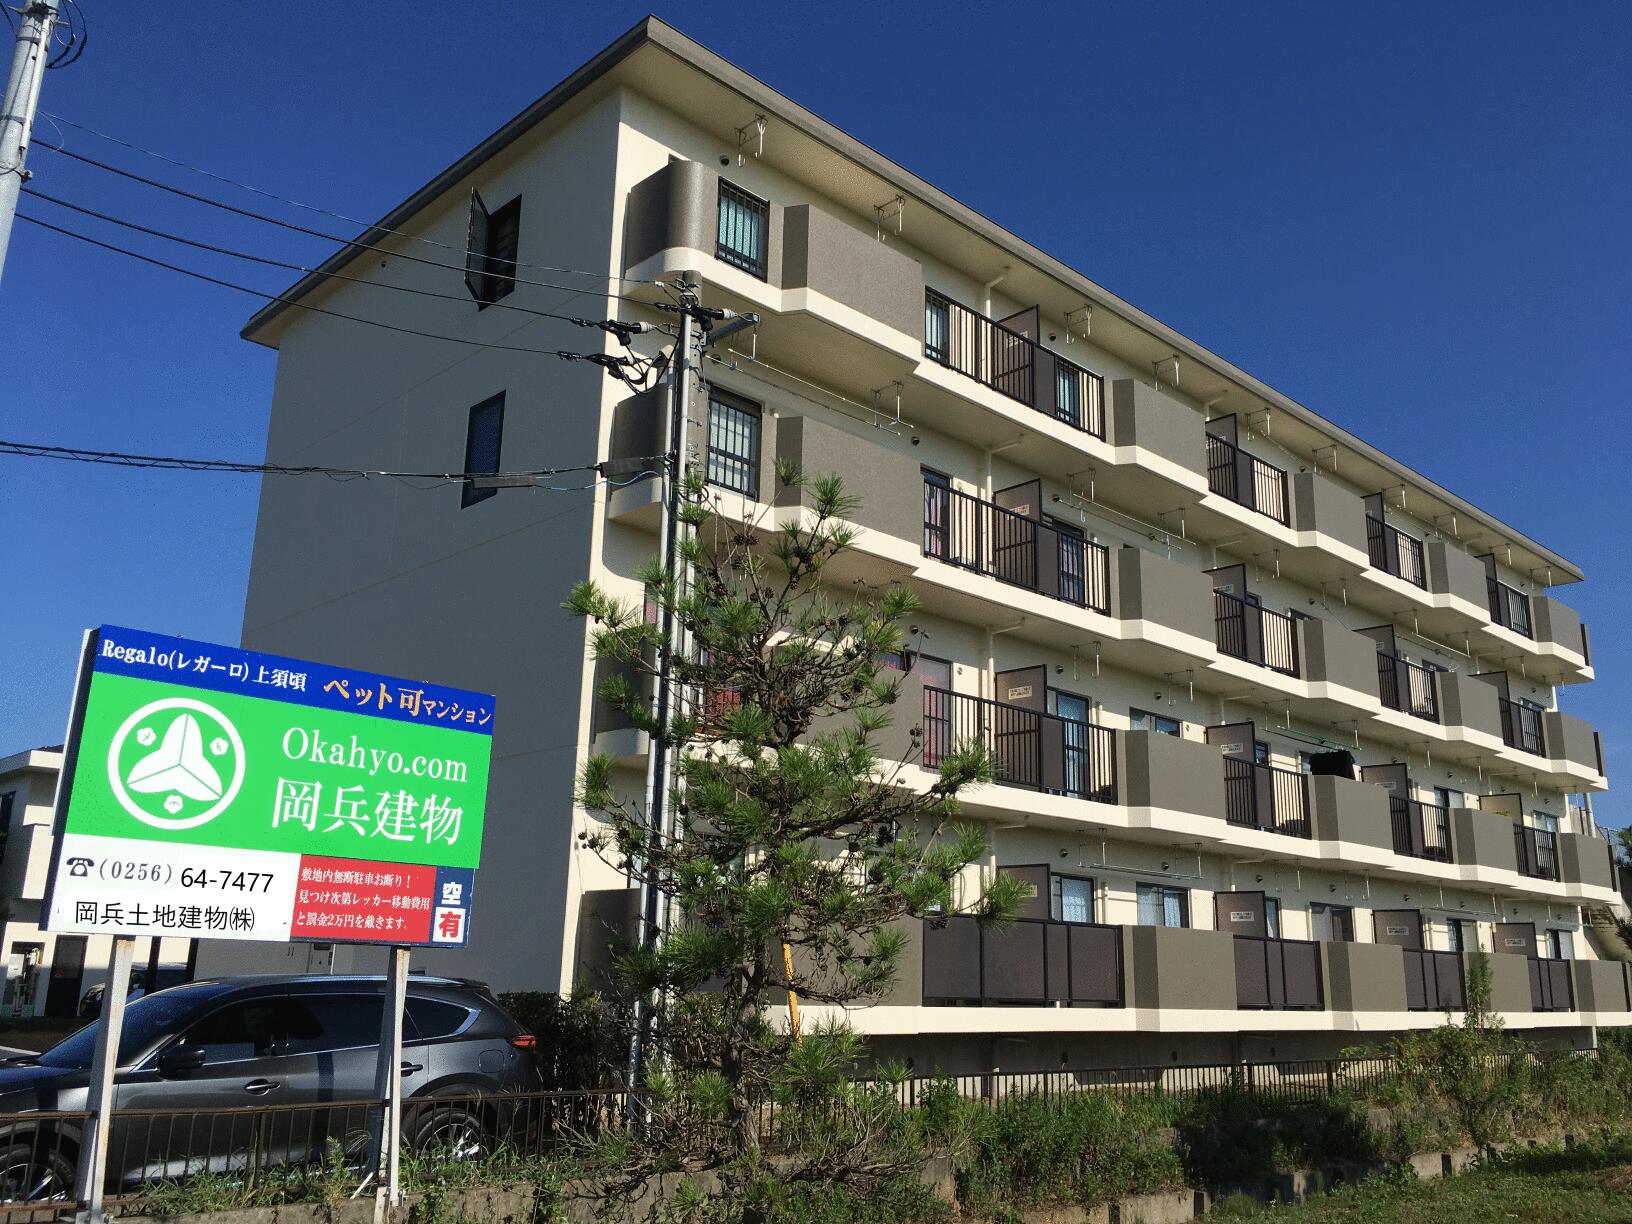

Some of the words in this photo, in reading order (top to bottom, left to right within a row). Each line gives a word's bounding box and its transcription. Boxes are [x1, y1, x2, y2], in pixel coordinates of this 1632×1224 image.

[252, 665, 308, 692] 上須頃
[282, 727, 468, 782] Okahyo.com
[272, 776, 463, 846] 岡兵建物
[99, 859, 173, 885] (0256)
[181, 867, 274, 893] 64-7477
[298, 889, 431, 911] 見つけ次第レッカー移動費用
